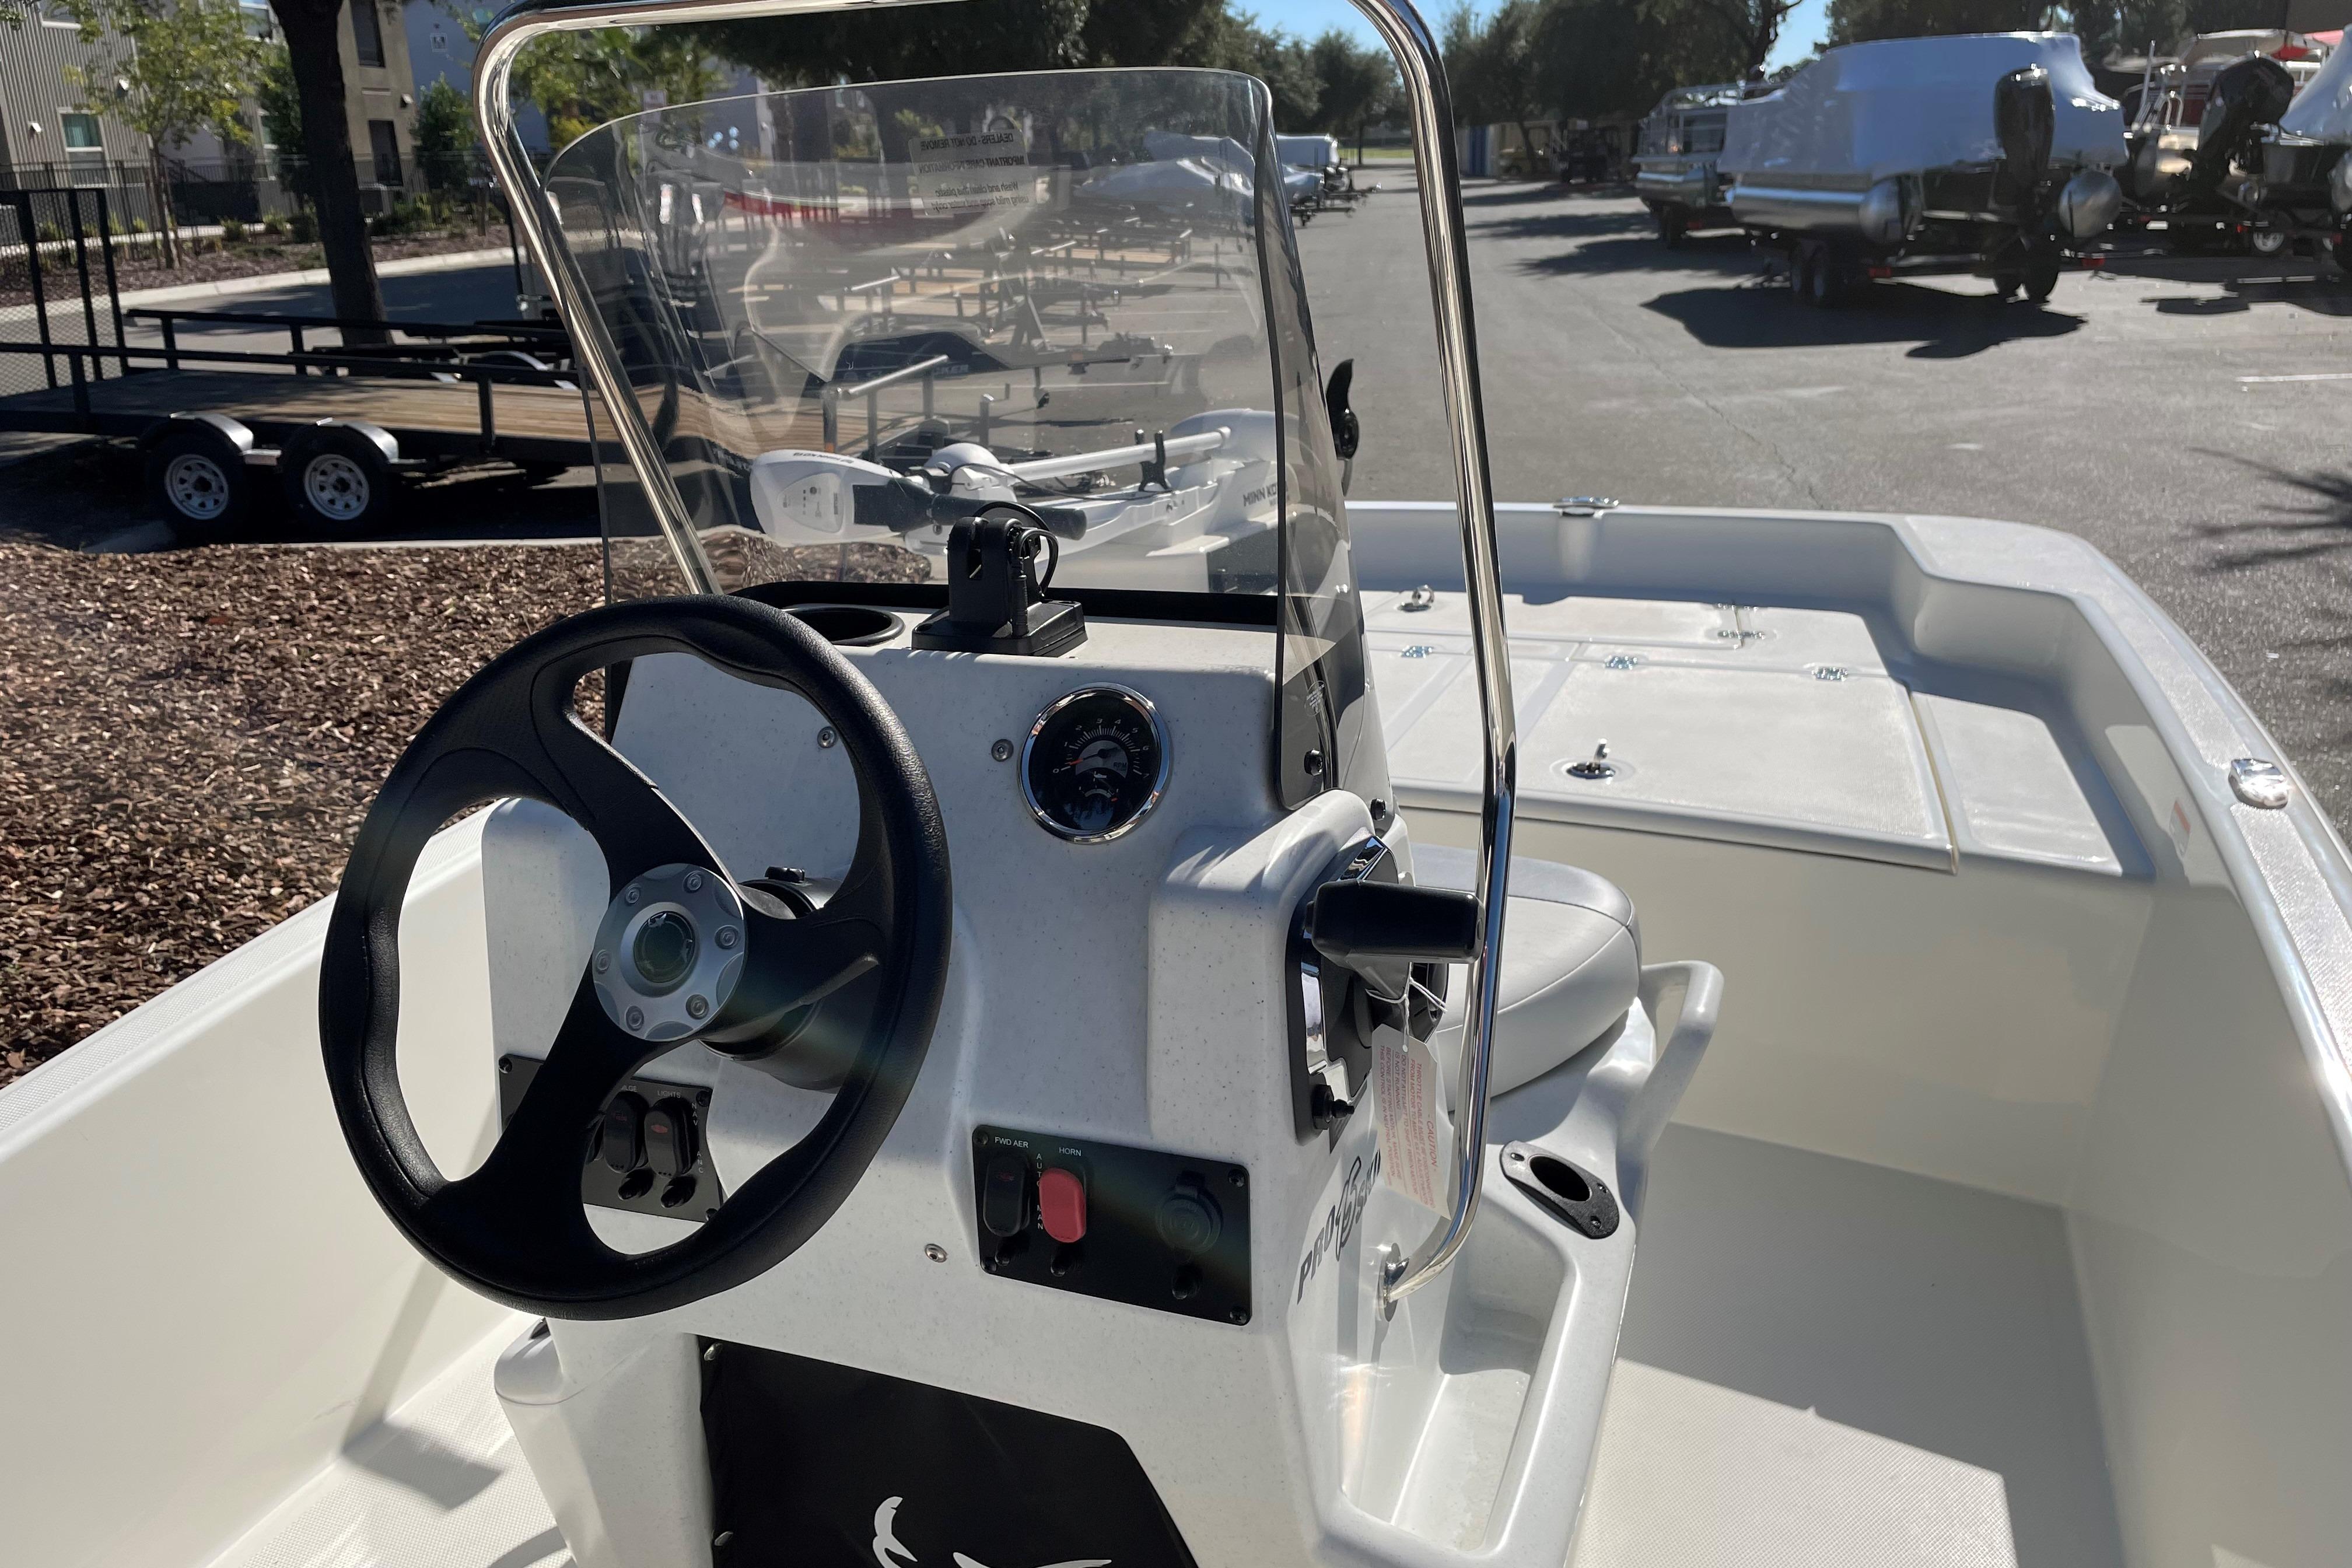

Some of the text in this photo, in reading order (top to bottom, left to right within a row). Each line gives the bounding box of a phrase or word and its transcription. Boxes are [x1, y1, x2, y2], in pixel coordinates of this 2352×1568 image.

[1242, 487, 1266, 507] MINN
[1395, 1051, 1400, 1059] IS
[657, 1090, 681, 1099] LIGHTS
[1386, 1077, 1394, 1112] STARTING
[1401, 1055, 1406, 1066] DO
[1404, 1118, 1409, 1127] TO
[1412, 1111, 1417, 1120] TO
[994, 1136, 1029, 1149] FWD AER
[1427, 1121, 1437, 1167] CAUTION
[1059, 1147, 1082, 1157] HORN
[1297, 1204, 1336, 1306] PRO
